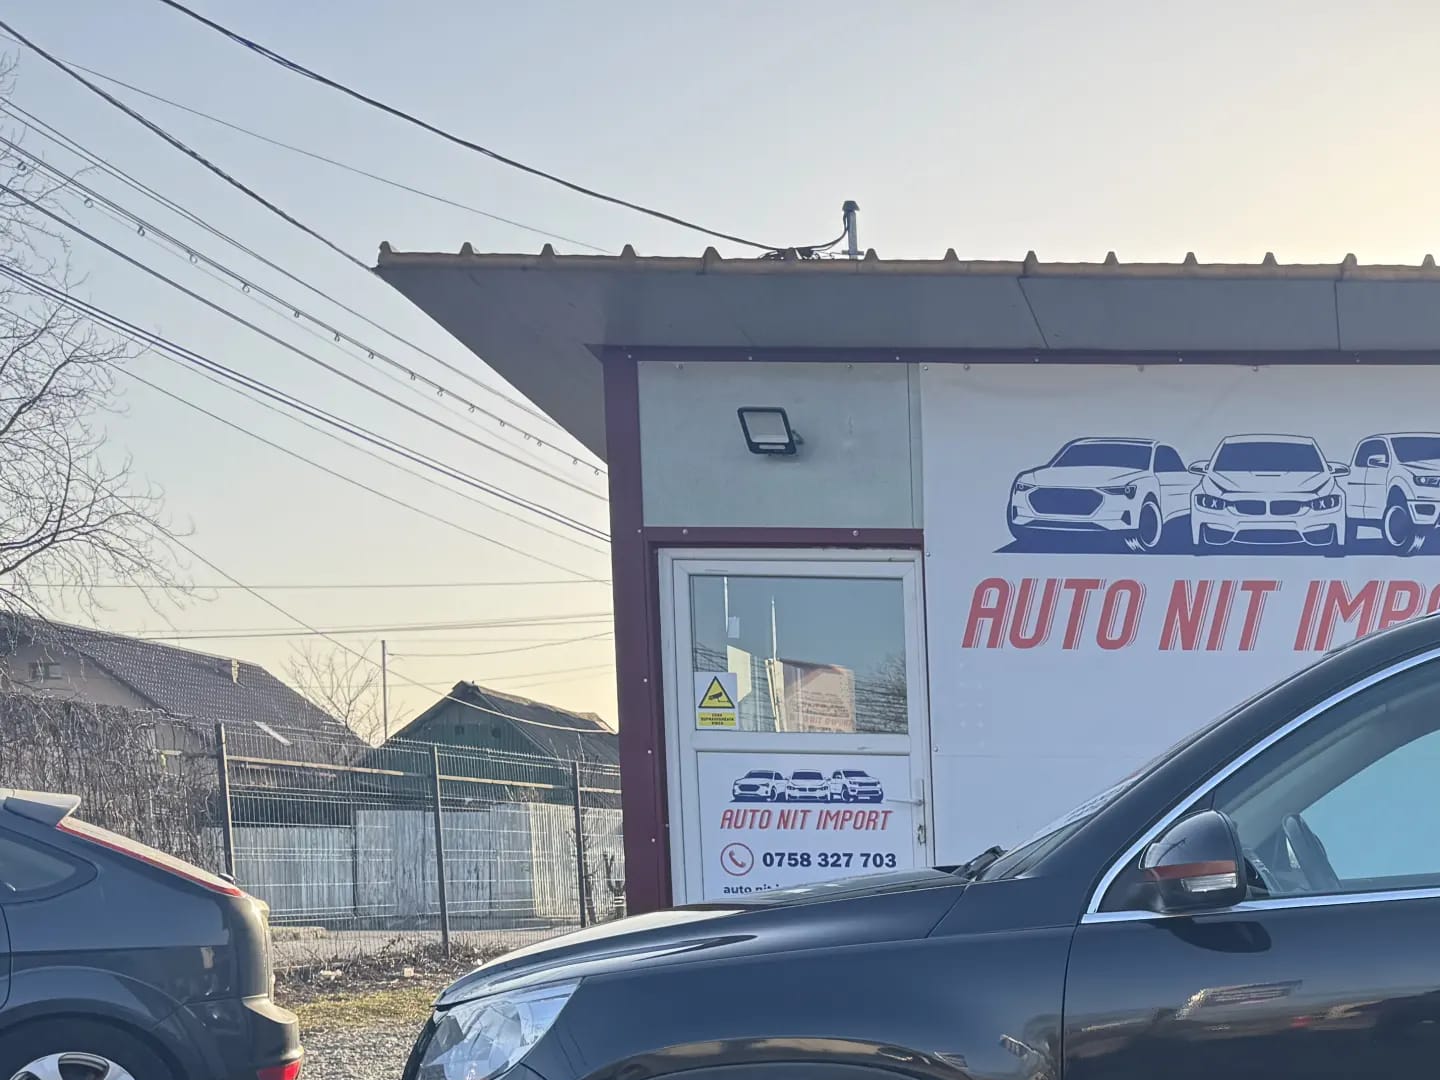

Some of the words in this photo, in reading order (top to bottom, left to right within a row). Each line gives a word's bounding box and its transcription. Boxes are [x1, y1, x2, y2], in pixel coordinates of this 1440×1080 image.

[961, 577, 1146, 650] AUTO
[1158, 580, 1282, 651] NIT
[720, 809, 773, 830] AUTO
[776, 810, 812, 830] NIT
[816, 810, 893, 831] IMPORT
[762, 852, 812, 867] 0758
[817, 853, 854, 868] 327
[860, 853, 897, 868] 703
[723, 885, 752, 894] auto
